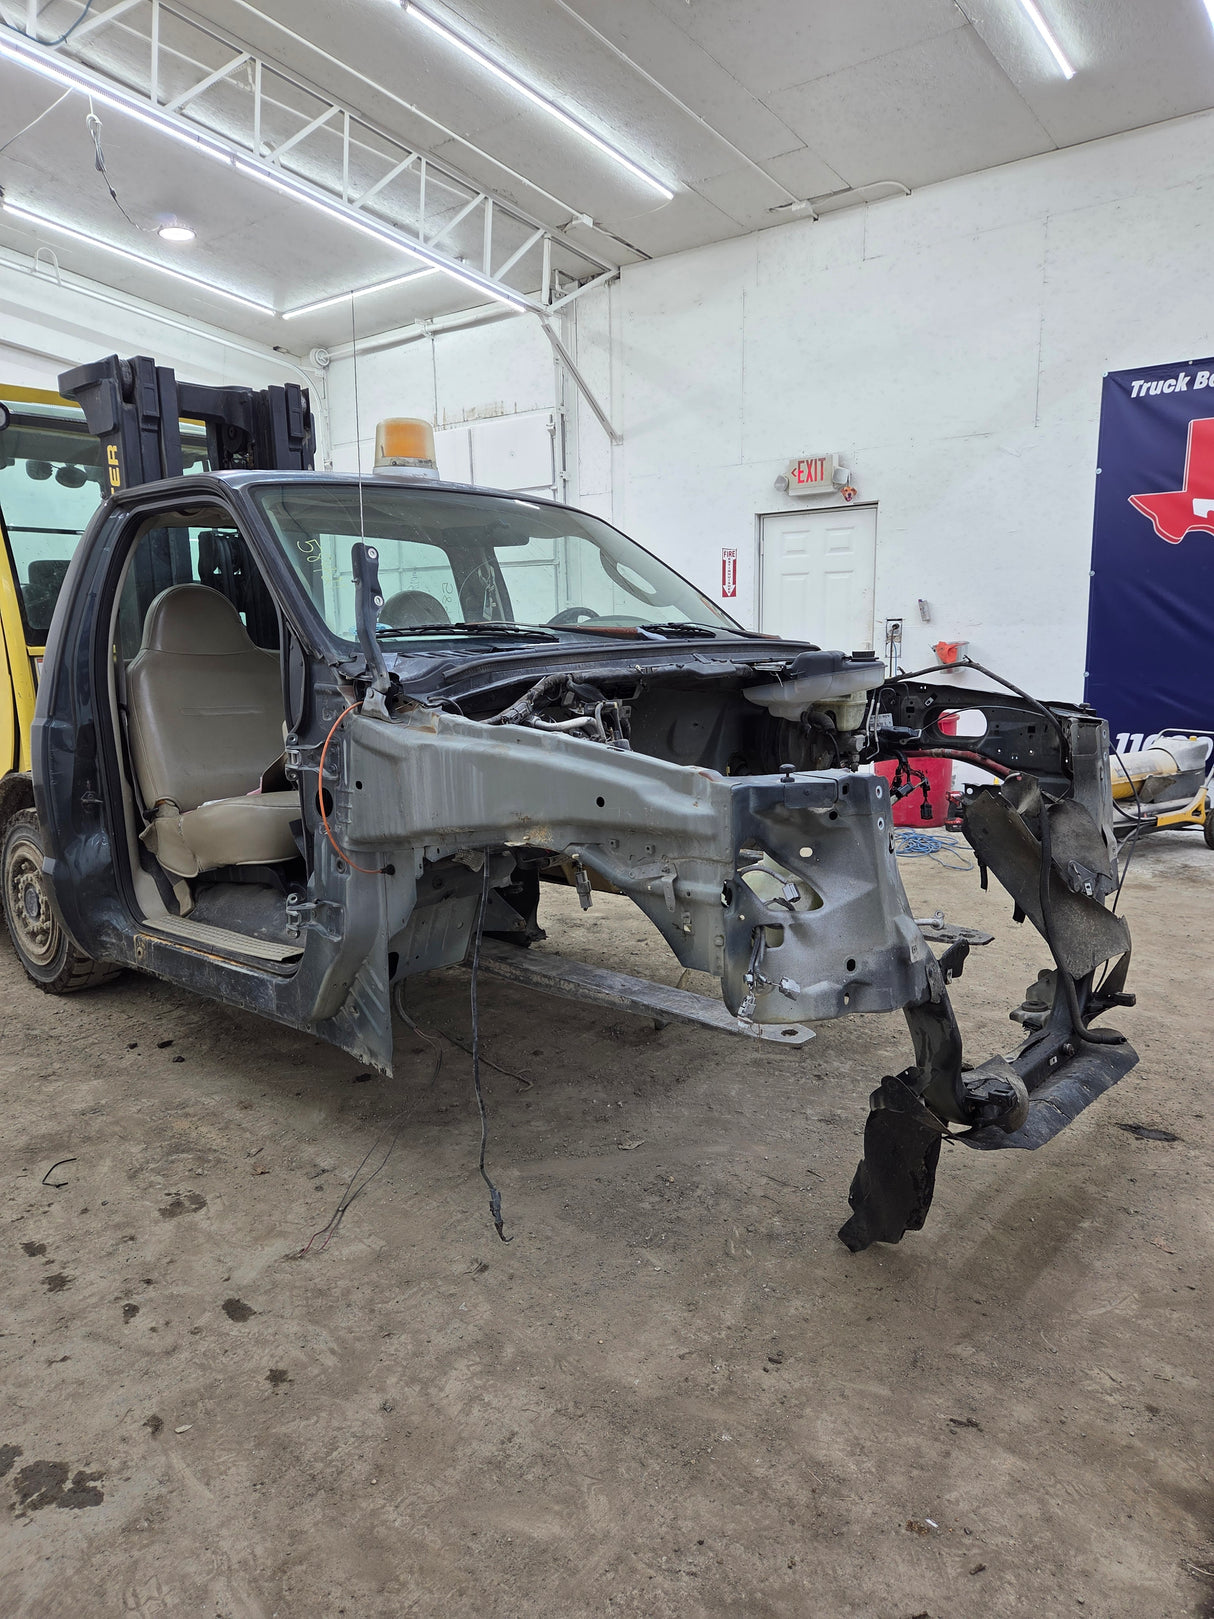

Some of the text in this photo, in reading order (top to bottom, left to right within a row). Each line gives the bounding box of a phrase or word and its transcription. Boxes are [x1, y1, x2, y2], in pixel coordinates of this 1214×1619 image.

[1130, 372, 1191, 399] Truck
[797, 457, 826, 484] EXIT
[723, 550, 736, 558] FIRE
